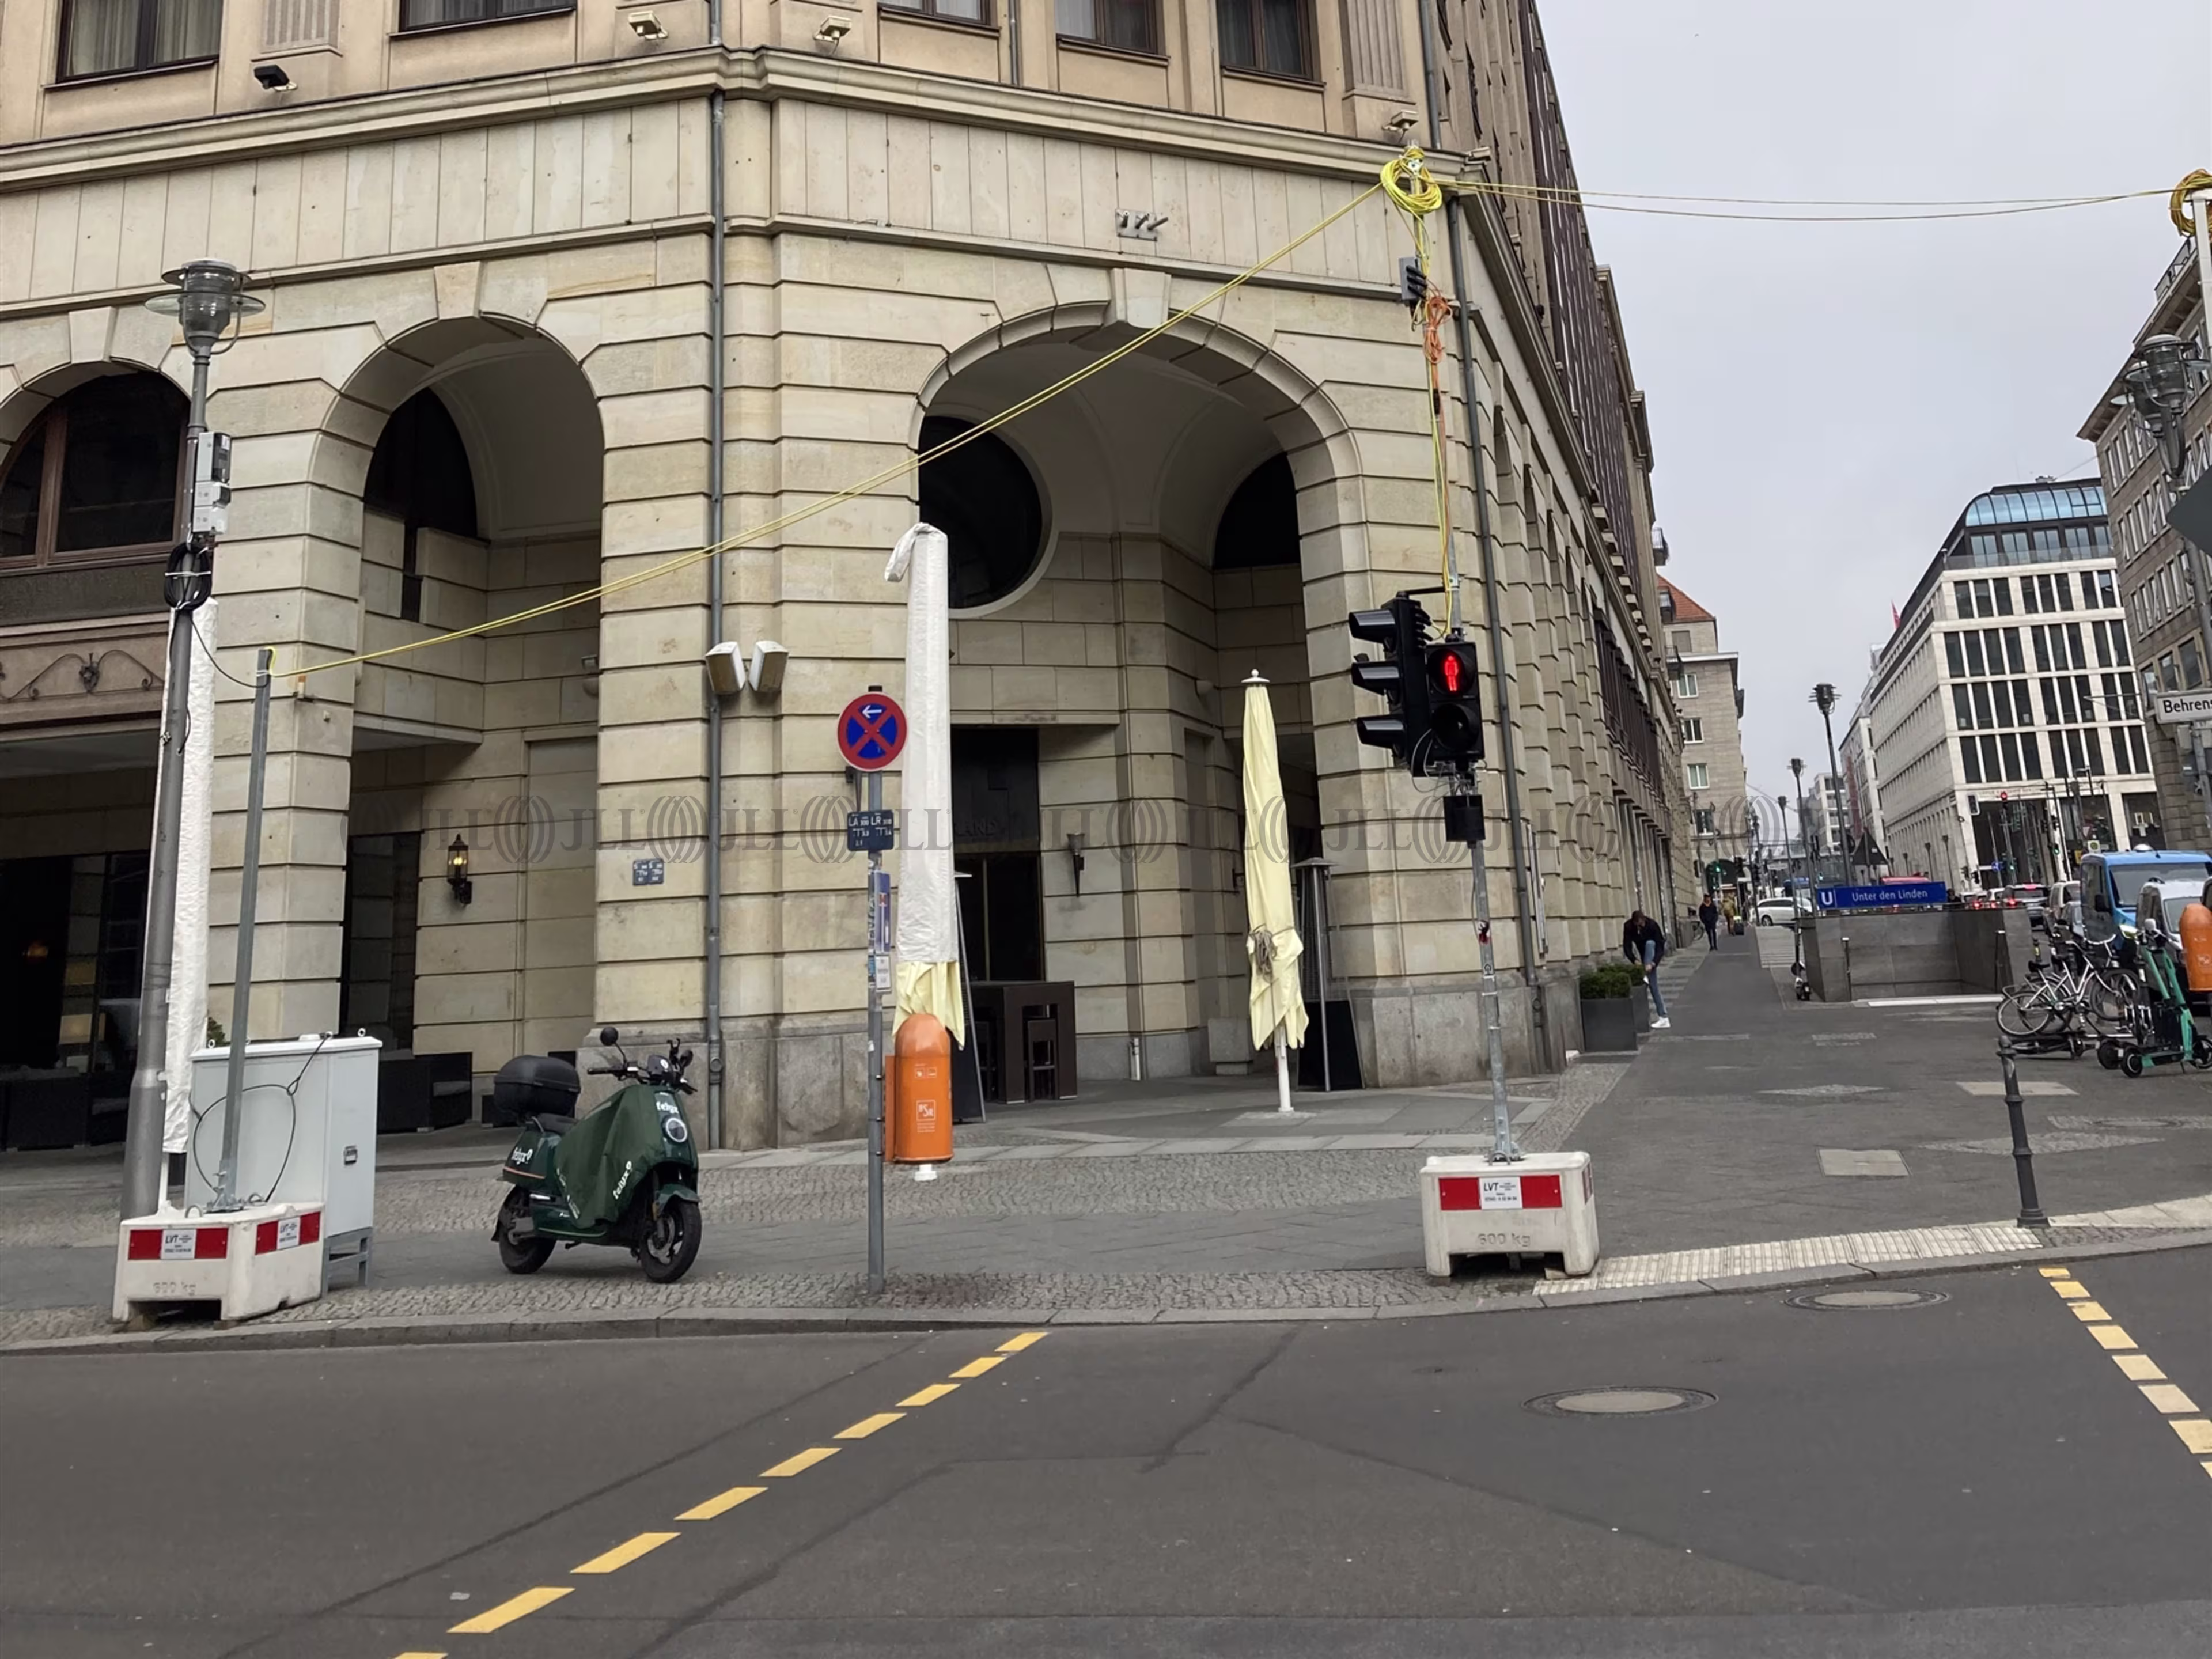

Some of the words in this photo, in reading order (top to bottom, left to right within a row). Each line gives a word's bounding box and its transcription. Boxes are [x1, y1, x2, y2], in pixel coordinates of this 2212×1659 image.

[2163, 698, 2212, 713] Behren
[1821, 891, 1834, 906] U
[1852, 891, 1877, 902] Unter
[1880, 891, 1896, 900] den
[1897, 889, 1929, 899] Linden
[1483, 1182, 1499, 1191] LVT
